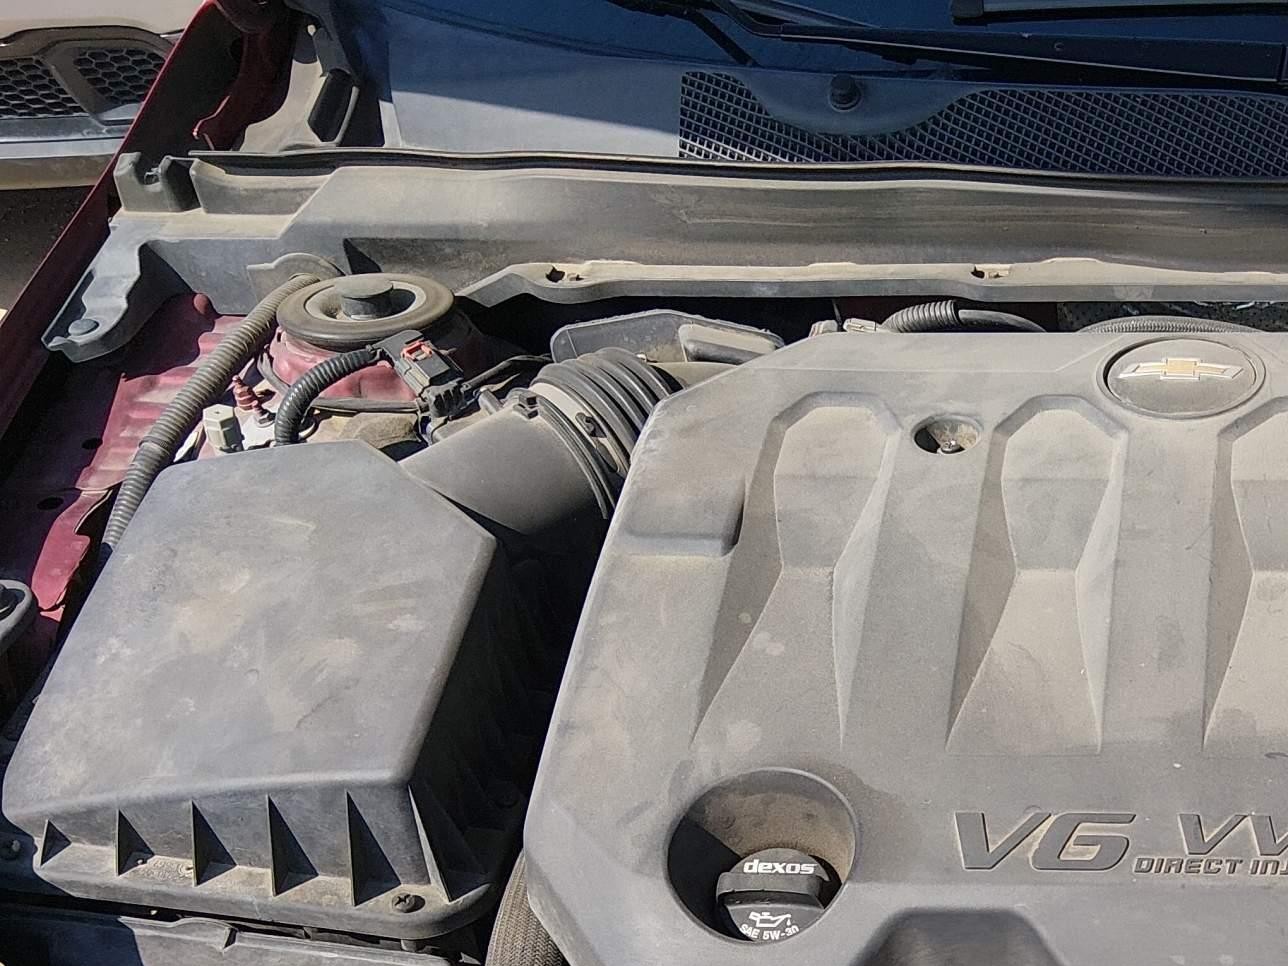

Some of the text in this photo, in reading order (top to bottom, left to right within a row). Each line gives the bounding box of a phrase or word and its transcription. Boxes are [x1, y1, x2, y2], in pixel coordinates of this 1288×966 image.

[954, 811, 1137, 872] V6
[743, 859, 818, 875] dexos
[1134, 857, 1244, 875] DIRECT
[740, 923, 760, 939] SAE
